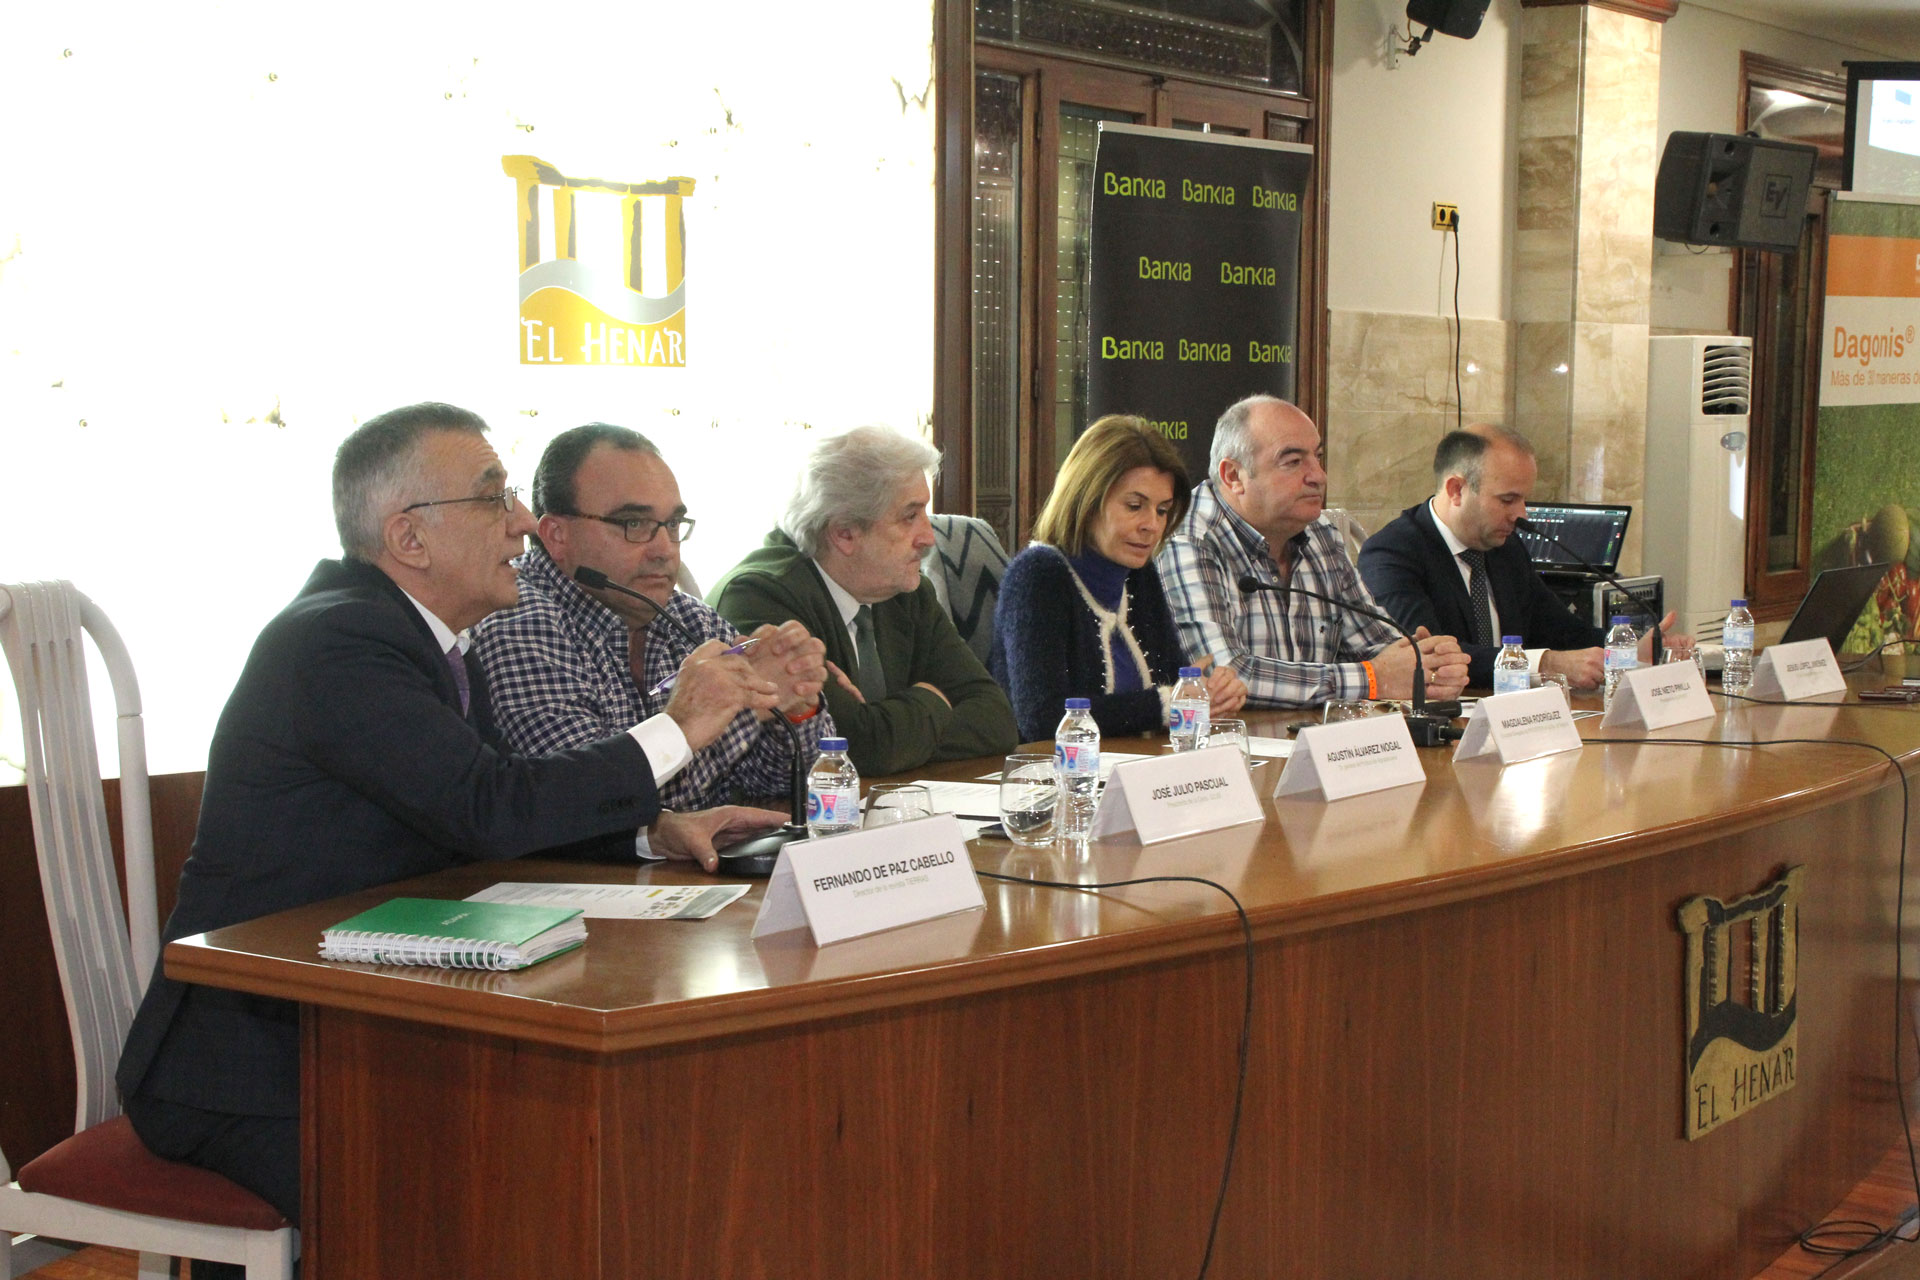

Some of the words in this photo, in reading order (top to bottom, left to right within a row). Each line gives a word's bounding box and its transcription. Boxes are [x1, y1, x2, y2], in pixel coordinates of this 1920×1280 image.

[1104, 172, 1166, 199] Bankia
[1182, 179, 1235, 205] Bankia
[1252, 186, 1297, 212] Bankia
[1139, 256, 1192, 282] Bankia
[1220, 262, 1276, 286] Bankia
[520, 316, 563, 362] EL
[580, 322, 684, 364] HENAR
[1102, 336, 1164, 360] Bankia
[1178, 338, 1231, 362] Bankia
[1138, 417, 1188, 440] ankia
[1380, 740, 1402, 752] NOGAL
[1173, 782, 1194, 796] JULIO
[1193, 777, 1229, 792] PASCUAL
[813, 868, 872, 892] FERNANDO
[872, 865, 889, 879] DE
[888, 861, 909, 876] PAZ
[909, 851, 955, 871] CABELLO
[1694, 1083, 1720, 1130] EL
[1731, 1046, 1795, 1112] HENAR
